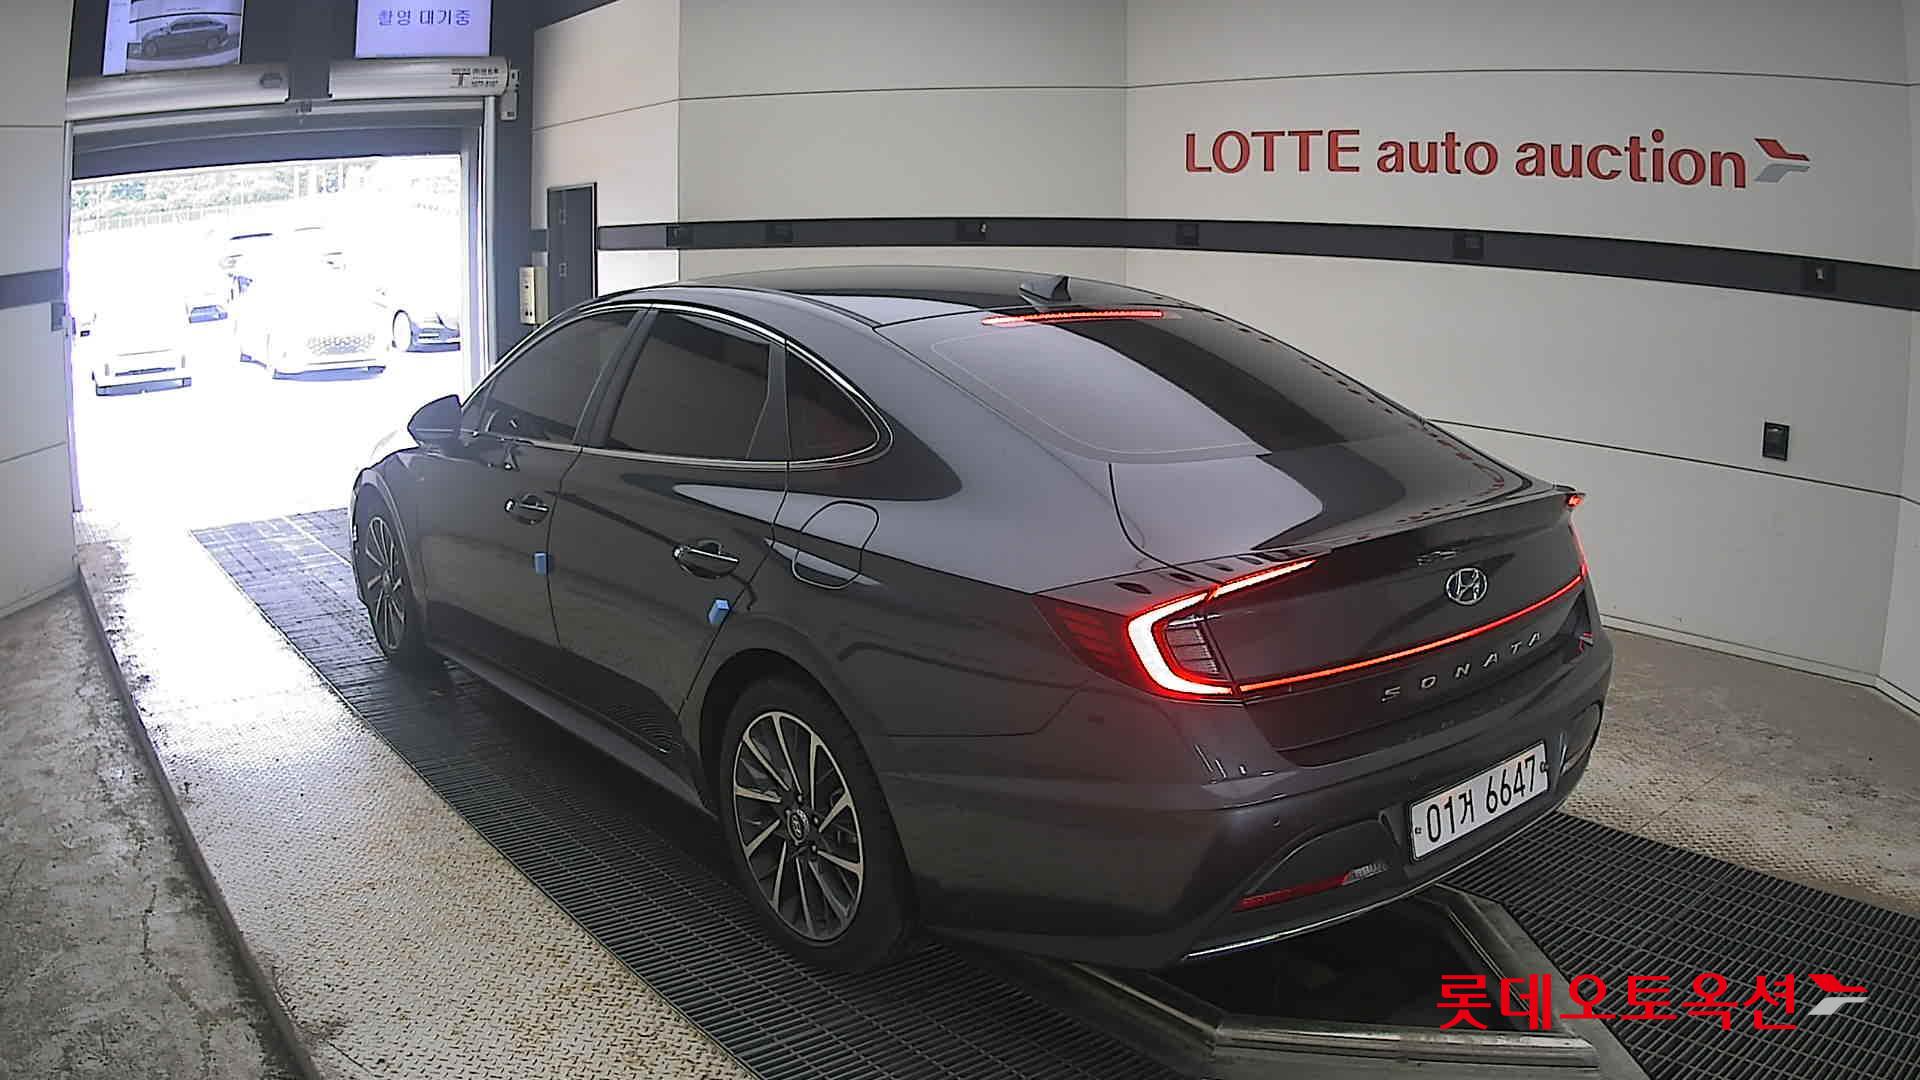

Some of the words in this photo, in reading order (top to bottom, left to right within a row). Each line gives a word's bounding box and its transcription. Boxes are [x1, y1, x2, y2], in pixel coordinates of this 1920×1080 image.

[419, 8, 473, 26] 대기중
[1185, 129, 1360, 173] LOTTE
[1376, 131, 1499, 176] auto
[1515, 128, 1747, 189] auction
[1381, 631, 1542, 702] SONATA
[1427, 789, 1475, 842] 01거
[1486, 755, 1536, 814] 6647
